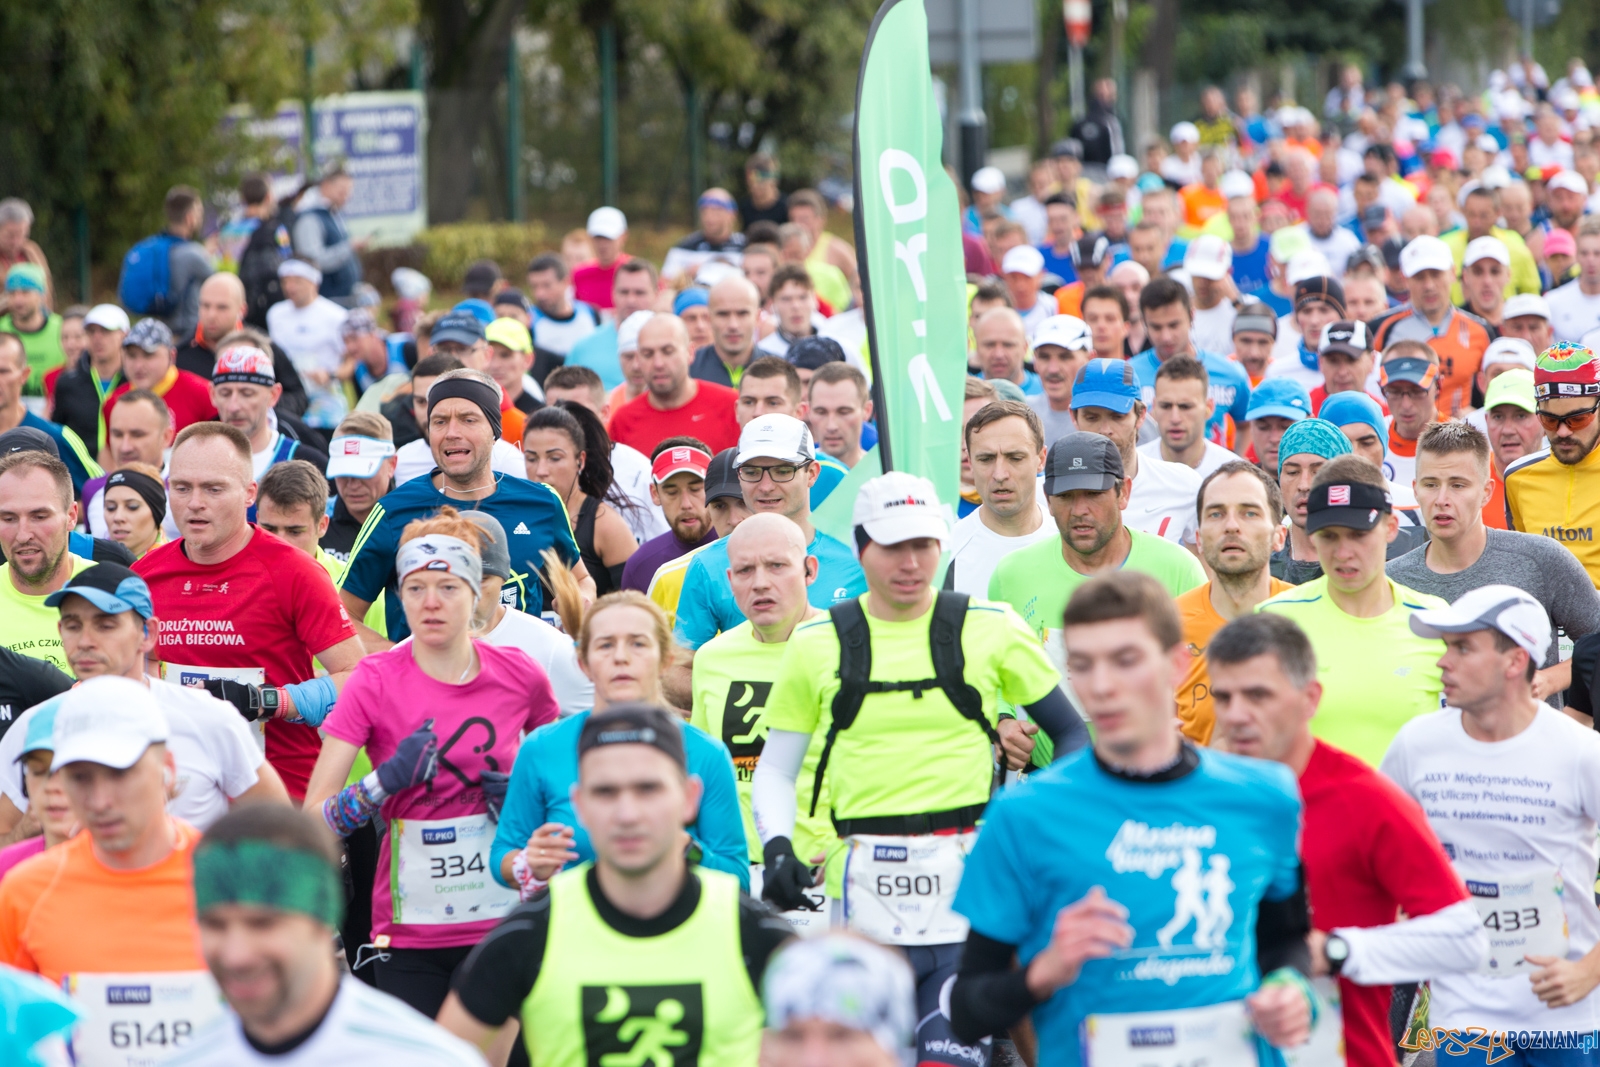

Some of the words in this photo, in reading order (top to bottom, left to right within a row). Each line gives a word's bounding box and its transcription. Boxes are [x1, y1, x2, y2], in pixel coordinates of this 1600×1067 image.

[158, 617, 234, 632] DRUŻYNOWA
[158, 634, 183, 646] LIGA
[186, 634, 245, 646] BIEGOWA
[431, 852, 485, 878] 334
[434, 881, 485, 894] Dominika
[877, 875, 941, 896] 6901
[1483, 907, 1540, 932] 433
